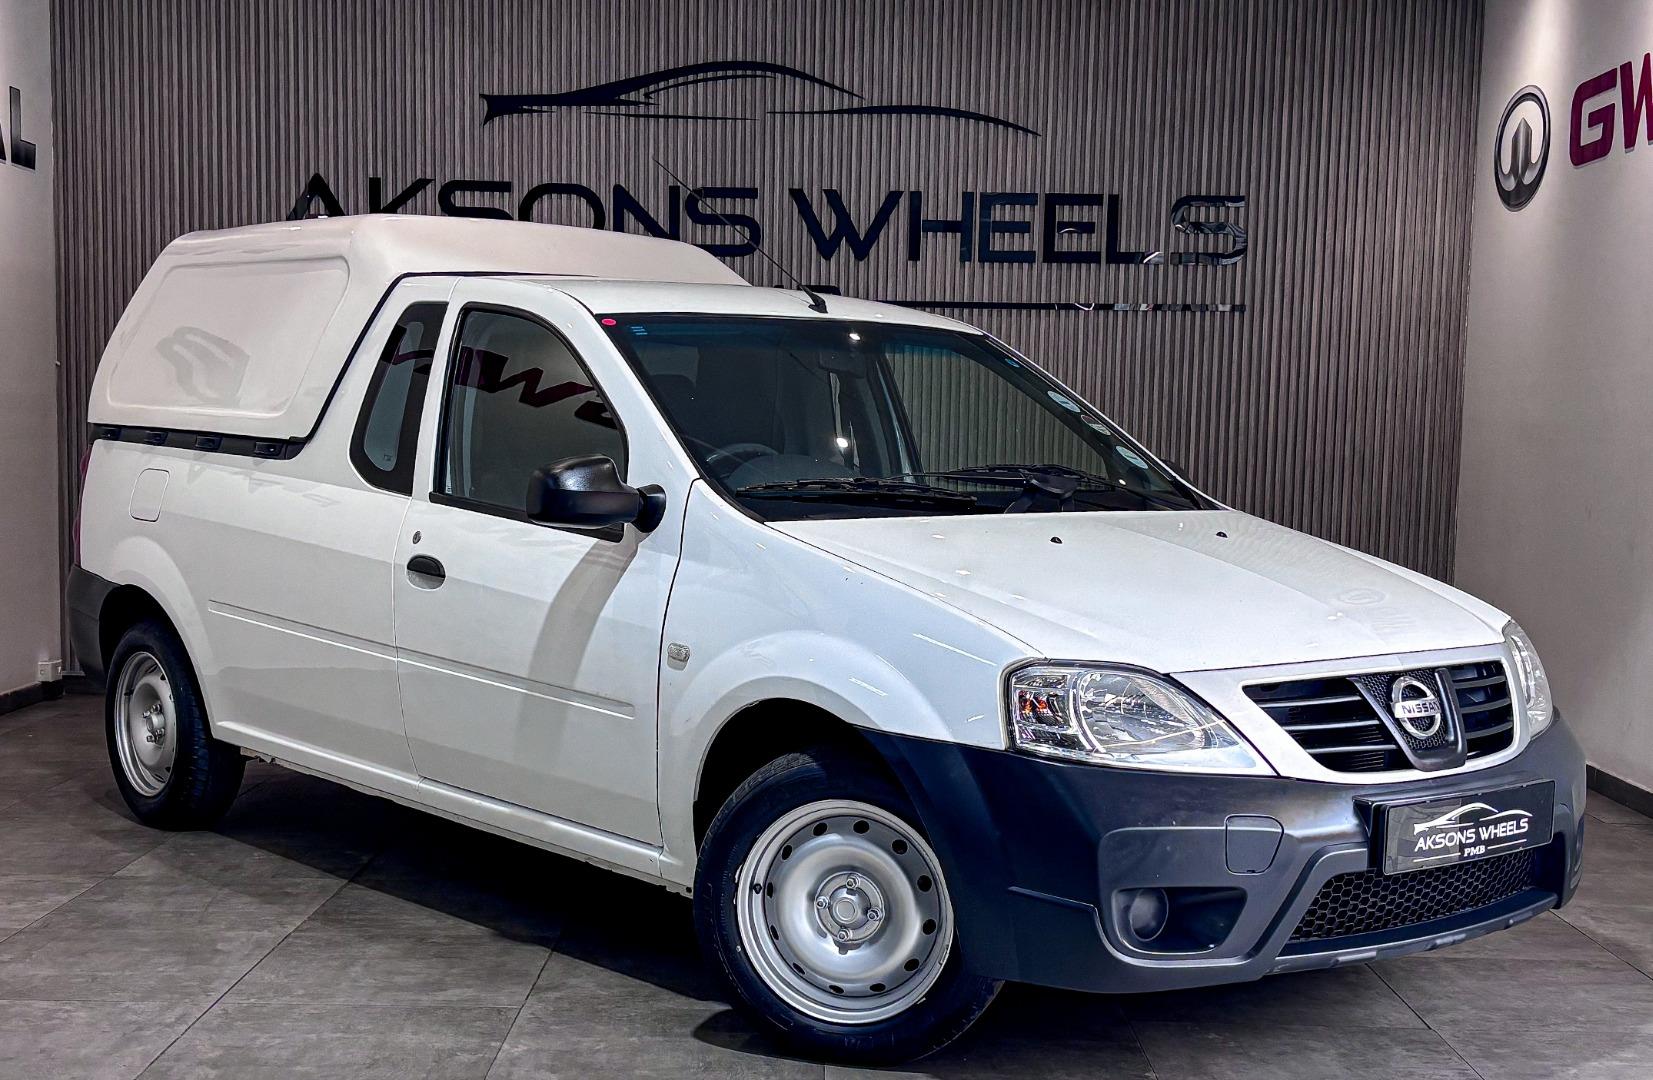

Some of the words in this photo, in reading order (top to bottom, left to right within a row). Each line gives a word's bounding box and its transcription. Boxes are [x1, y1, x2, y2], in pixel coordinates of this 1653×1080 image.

[788, 187, 1248, 266] WHEELS
[1402, 700, 1440, 714] NISSAN
[1415, 828, 1476, 851] AKSONS
[1479, 818, 1529, 841] WHEELS
[1464, 845, 1486, 857] PMB
